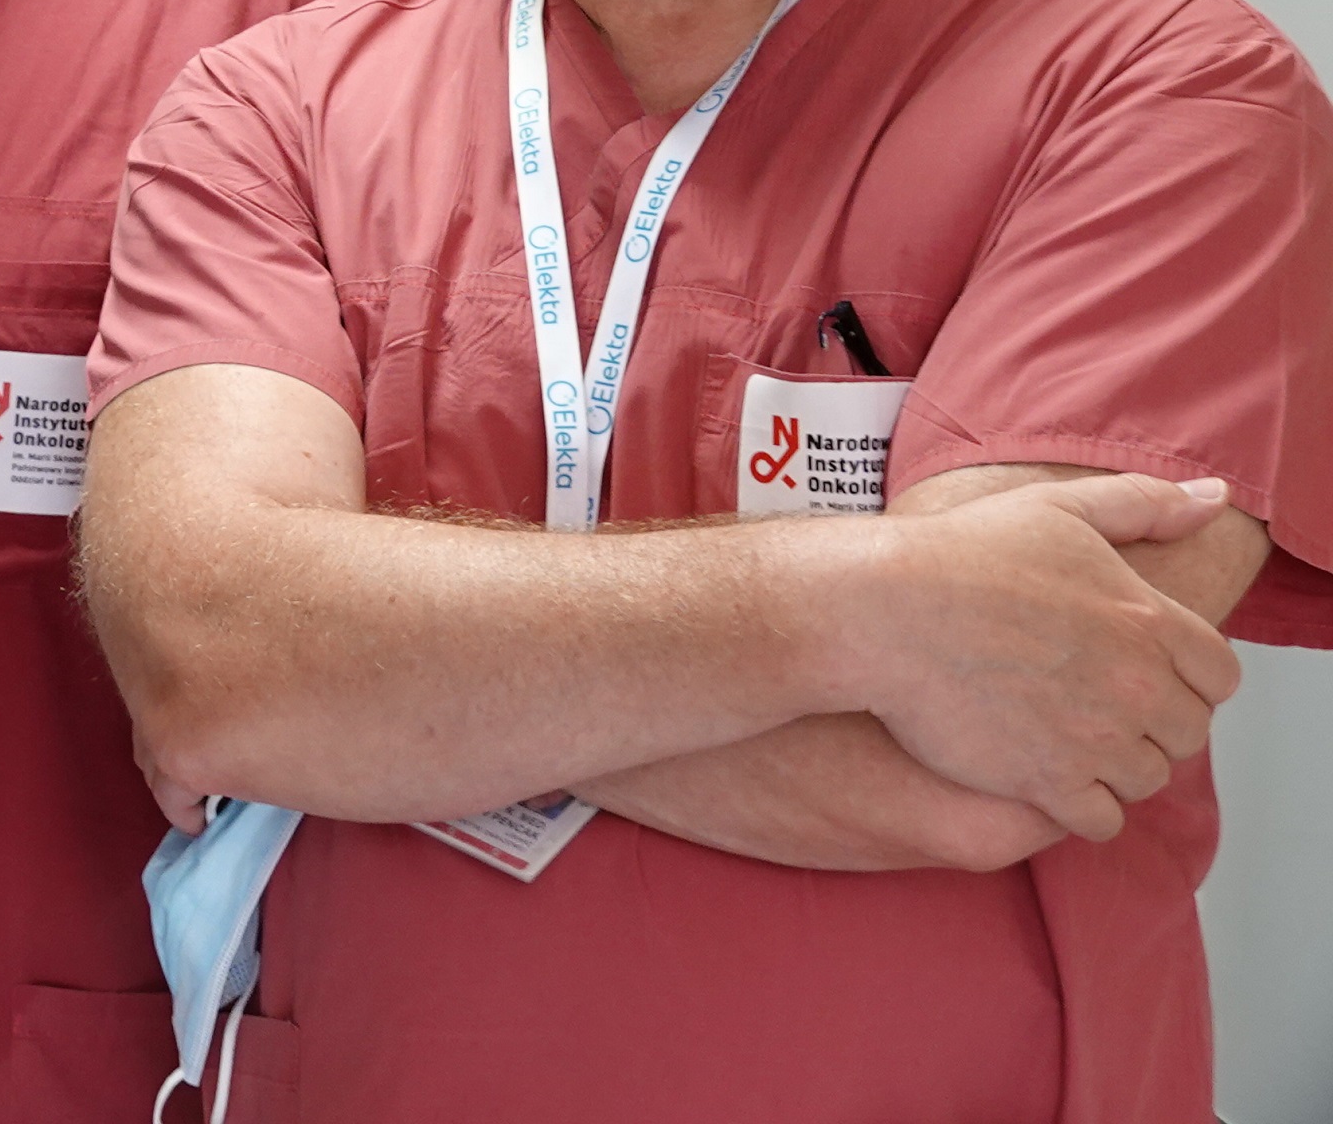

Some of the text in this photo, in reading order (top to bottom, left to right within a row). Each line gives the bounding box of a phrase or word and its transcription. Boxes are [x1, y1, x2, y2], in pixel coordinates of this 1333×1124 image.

[518, 108, 541, 175] Elekta
[635, 158, 682, 232] Elekta
[534, 246, 562, 326] Elekta
[591, 322, 629, 405] Elekta
[13, 431, 86, 451] Onkolog
[14, 414, 86, 432] Instytut
[551, 411, 578, 490] Elekta
[806, 433, 890, 452] Narodow
[808, 476, 884, 495] Onkolo
